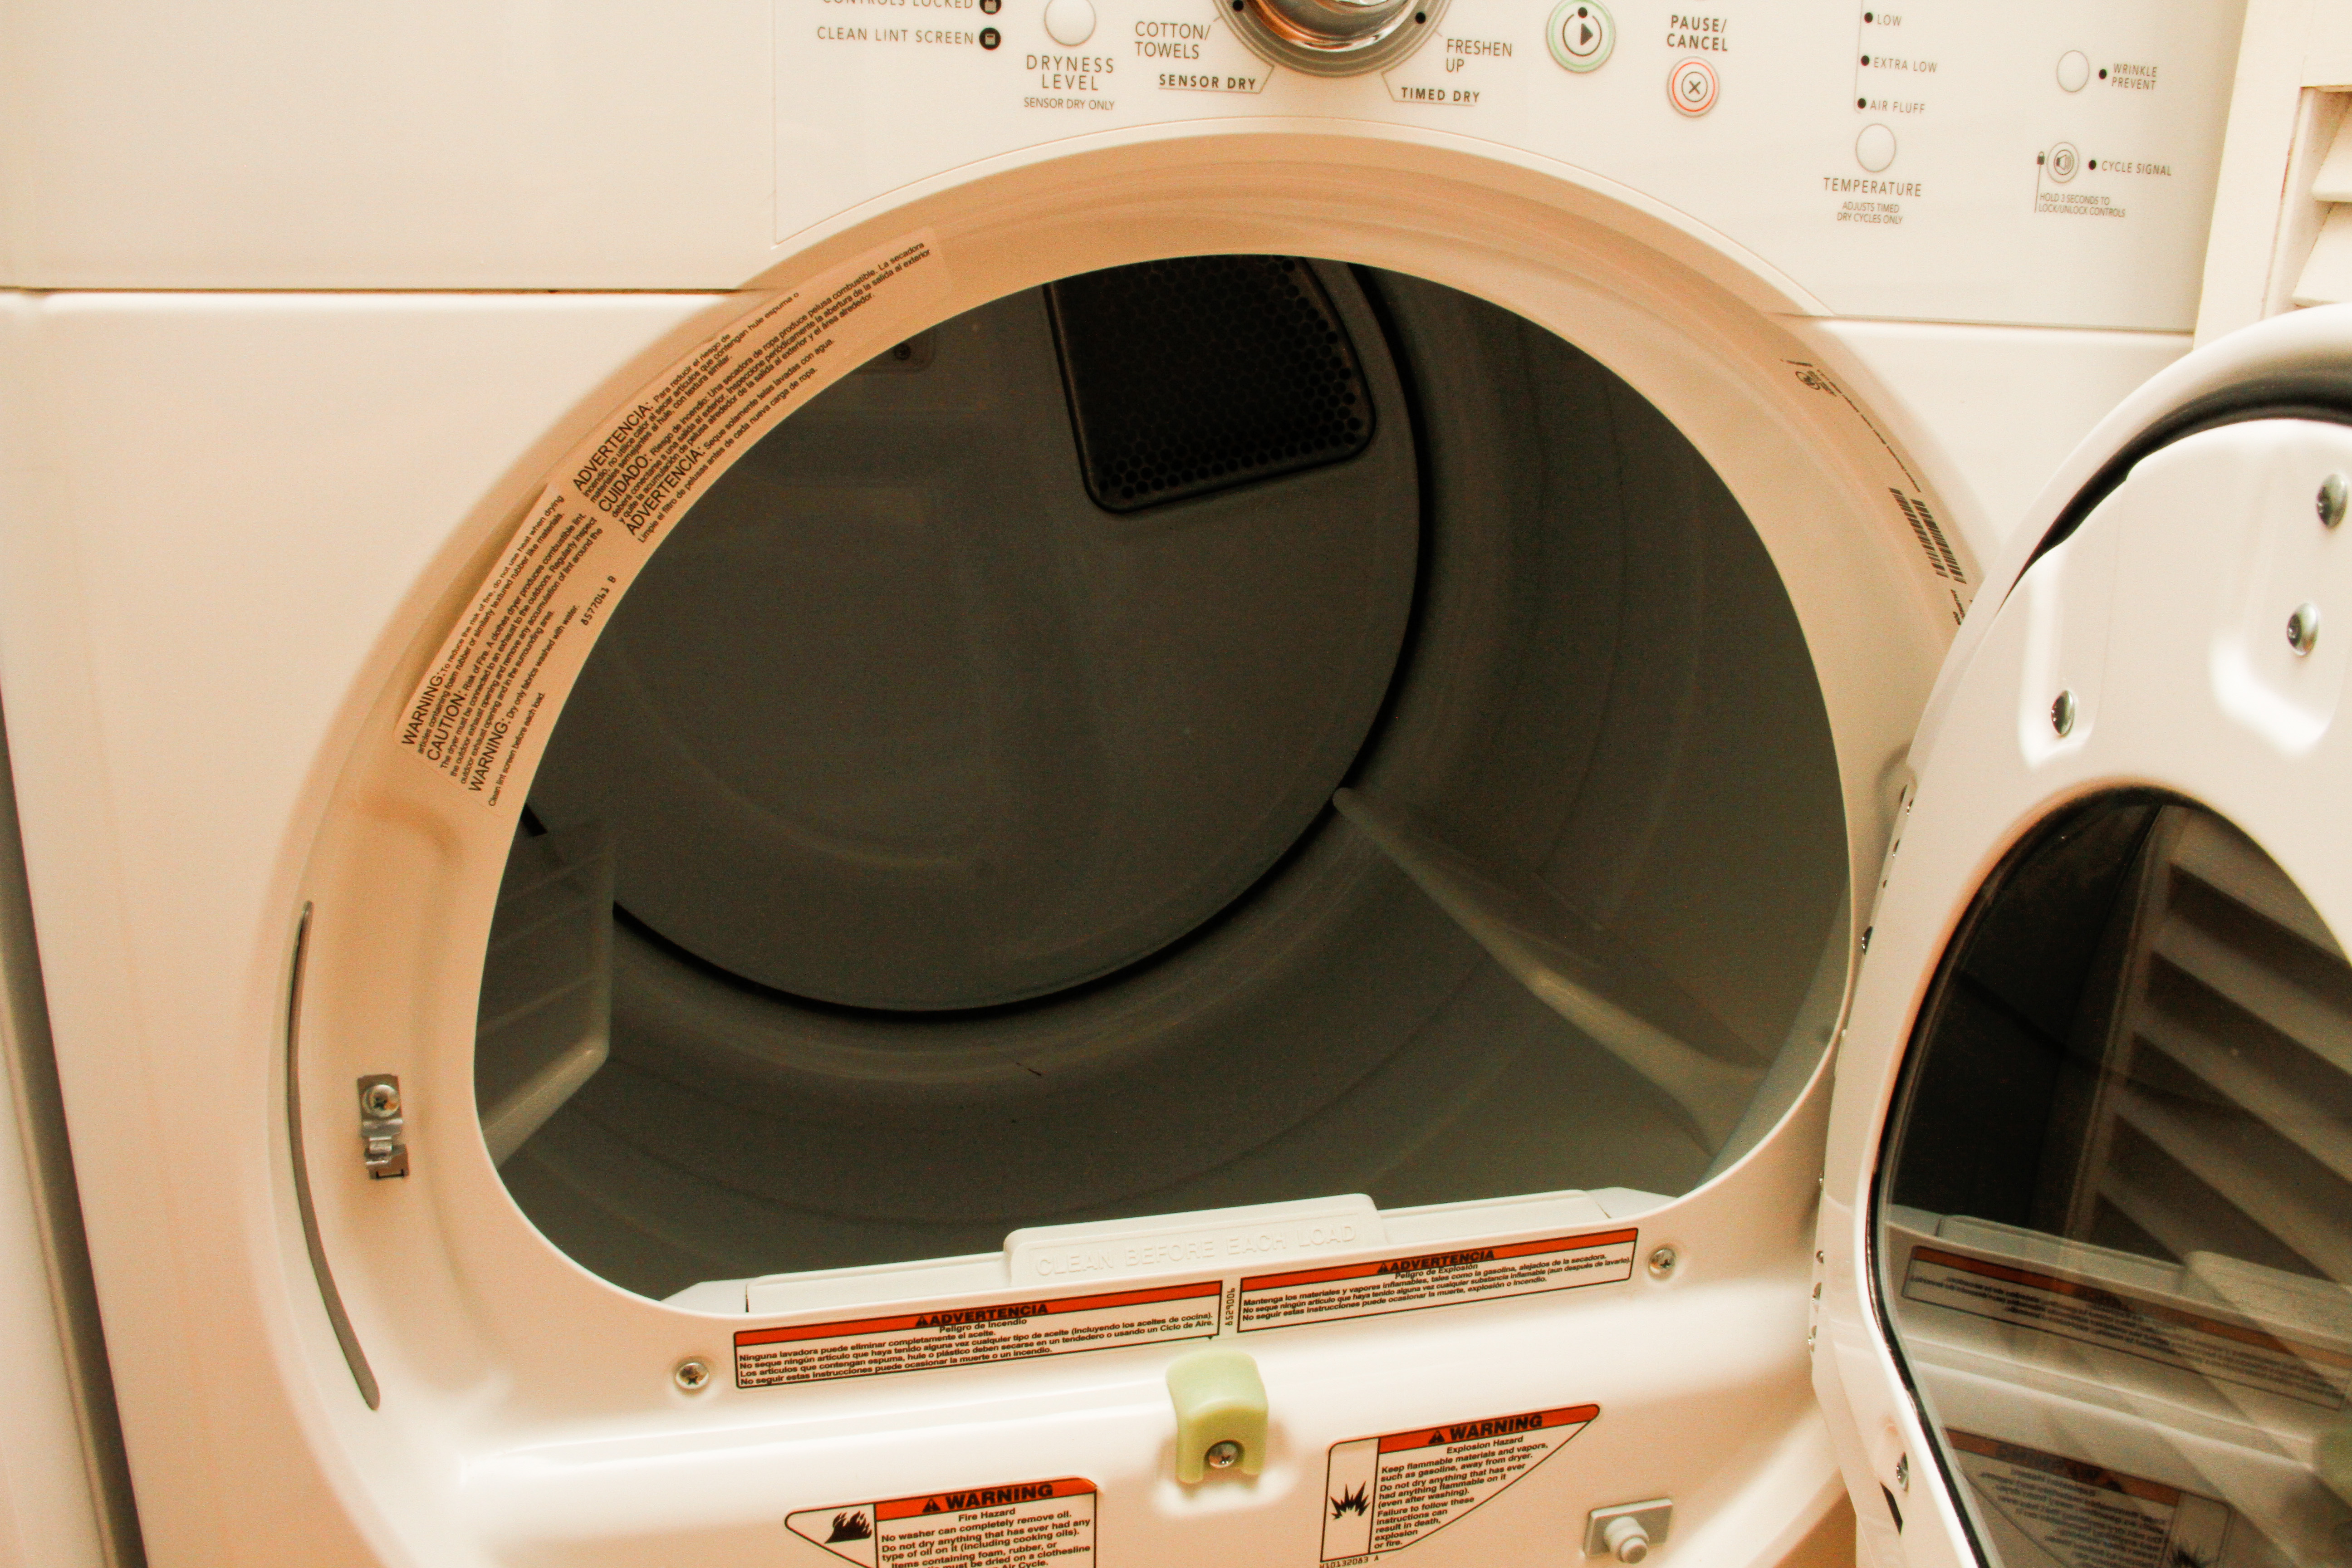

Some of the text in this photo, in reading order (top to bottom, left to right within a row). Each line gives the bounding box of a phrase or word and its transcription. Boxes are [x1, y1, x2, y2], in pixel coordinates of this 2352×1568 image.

[1670, 15, 1727, 34] PAUSE/
[1877, 14, 1902, 26] LOW
[817, 26, 974, 44] CLEAN LINT SCREEN
[1135, 20, 1211, 40] COTTON/
[1135, 41, 1200, 60] TOWELS
[1446, 38, 1512, 57] FRESHEN
[1666, 33, 1728, 52] CANCEL
[1026, 54, 1113, 74] DRYNESS
[1446, 58, 1465, 73] UP
[1873, 57, 1937, 73] EXTRA LOW
[2112, 64, 2157, 79] WRINKLE
[1042, 74, 1098, 91] LEVEL
[1159, 74, 1255, 90] SENSOR DRY
[2112, 77, 2156, 90] PREVENT
[1024, 97, 1115, 111] SENSOR DRY ONLY
[1401, 87, 1480, 103] TIMED DRY
[1870, 100, 1925, 114] AIR FLUFF
[2102, 160, 2171, 176] CYCLE SIGNAL
[1823, 177, 1921, 197] TEMPERATURE
[1842, 201, 1900, 214] ADJUSTS TIMED
[2040, 192, 2110, 206] HOLD 3 SECONDS TO
[1837, 212, 1903, 225] DRY CYCLES ONLY
[2038, 203, 2126, 218] LOCK/UNLOCK CONTROLS
[573, 402, 653, 491] ADVERTENCIA:
[598, 454, 652, 512] CUIDADO:
[626, 446, 706, 536] ADVERTENCIA:
[580, 587, 610, 626] 8577061
[468, 605, 580, 791] WARNING: Dry only fabrics washed with water.
[402, 671, 446, 745] WARNING:
[427, 691, 467, 761] CAUTION:
[488, 693, 546, 807] Clean lint screen before each load.
[1036, 1225, 1357, 1276] CLEAN BEFORE EACH LOAD
[1391, 1250, 1494, 1272] ADVERTENCIA
[1395, 1269, 1424, 1279] Peligro
[1438, 1263, 1478, 1274] Explosión
[930, 1304, 1048, 1325] ADVERTENCIA
[939, 1324, 973, 1333] Peligro
[988, 1318, 1027, 1328] Incendio
[1451, 1416, 1543, 1440] WARNING
[1446, 1435, 1524, 1454] Explosion Hazard
[1381, 1473, 1403, 1482] such
[1418, 1465, 1458, 1478] gasoline,
[1460, 1461, 1483, 1470] away
[1485, 1457, 1506, 1465] from
[1508, 1450, 1533, 1462] dryer.
[1382, 1443, 1548, 1474] Keep flammable materials and vapors,
[1395, 1481, 1410, 1490] not
[1428, 1473, 1468, 1485] anything
[1470, 1469, 1487, 1478] that
[1506, 1463, 1525, 1471] ever
[946, 1484, 1054, 1509] WARNING
[1378, 1487, 1469, 1509] (even after washing).
[1379, 1491, 1396, 1500] had
[1398, 1486, 1437, 1498] anything
[1439, 1478, 1485, 1490] flammable
[958, 1507, 1016, 1522] Fire Hazard
[1377, 1508, 1408, 1518] Failure
[1421, 1501, 1448, 1510] follow
[1450, 1497, 1475, 1505] these
[881, 1534, 896, 1543] No
[898, 1530, 935, 1540] washer
[959, 1519, 1014, 1532] completely
[1017, 1514, 1054, 1524] remove
[1057, 1510, 1072, 1519] oil.
[1376, 1523, 1401, 1534] result
[1414, 1517, 1441, 1527] death,
[1377, 1512, 1430, 1525] instructions
[899, 1542, 916, 1550] not
[918, 1540, 935, 1550] dry
[938, 1534, 982, 1547] anything
[985, 1530, 1004, 1539] that
[1027, 1525, 1049, 1533] ever
[1052, 1520, 1070, 1530] had
[1073, 1519, 1091, 1530] any
[1374, 1529, 1418, 1542] explosion
[882, 1553, 905, 1563] type
[906, 1549, 917, 1558] of
[920, 1547, 933, 1556] oil
[951, 1544, 958, 1552] it
[960, 1539, 1010, 1552] (including
[1013, 1533, 1053, 1544] cooking
[1055, 1528, 1079, 1538] oils).
[922, 1553, 975, 1566] containing
[978, 1550, 1006, 1558] foam,
[1008, 1544, 1044, 1557] rubber,
[969, 1559, 983, 1568] be
[985, 1556, 1011, 1566] dried
[1037, 1546, 1091, 1558] clothesline
